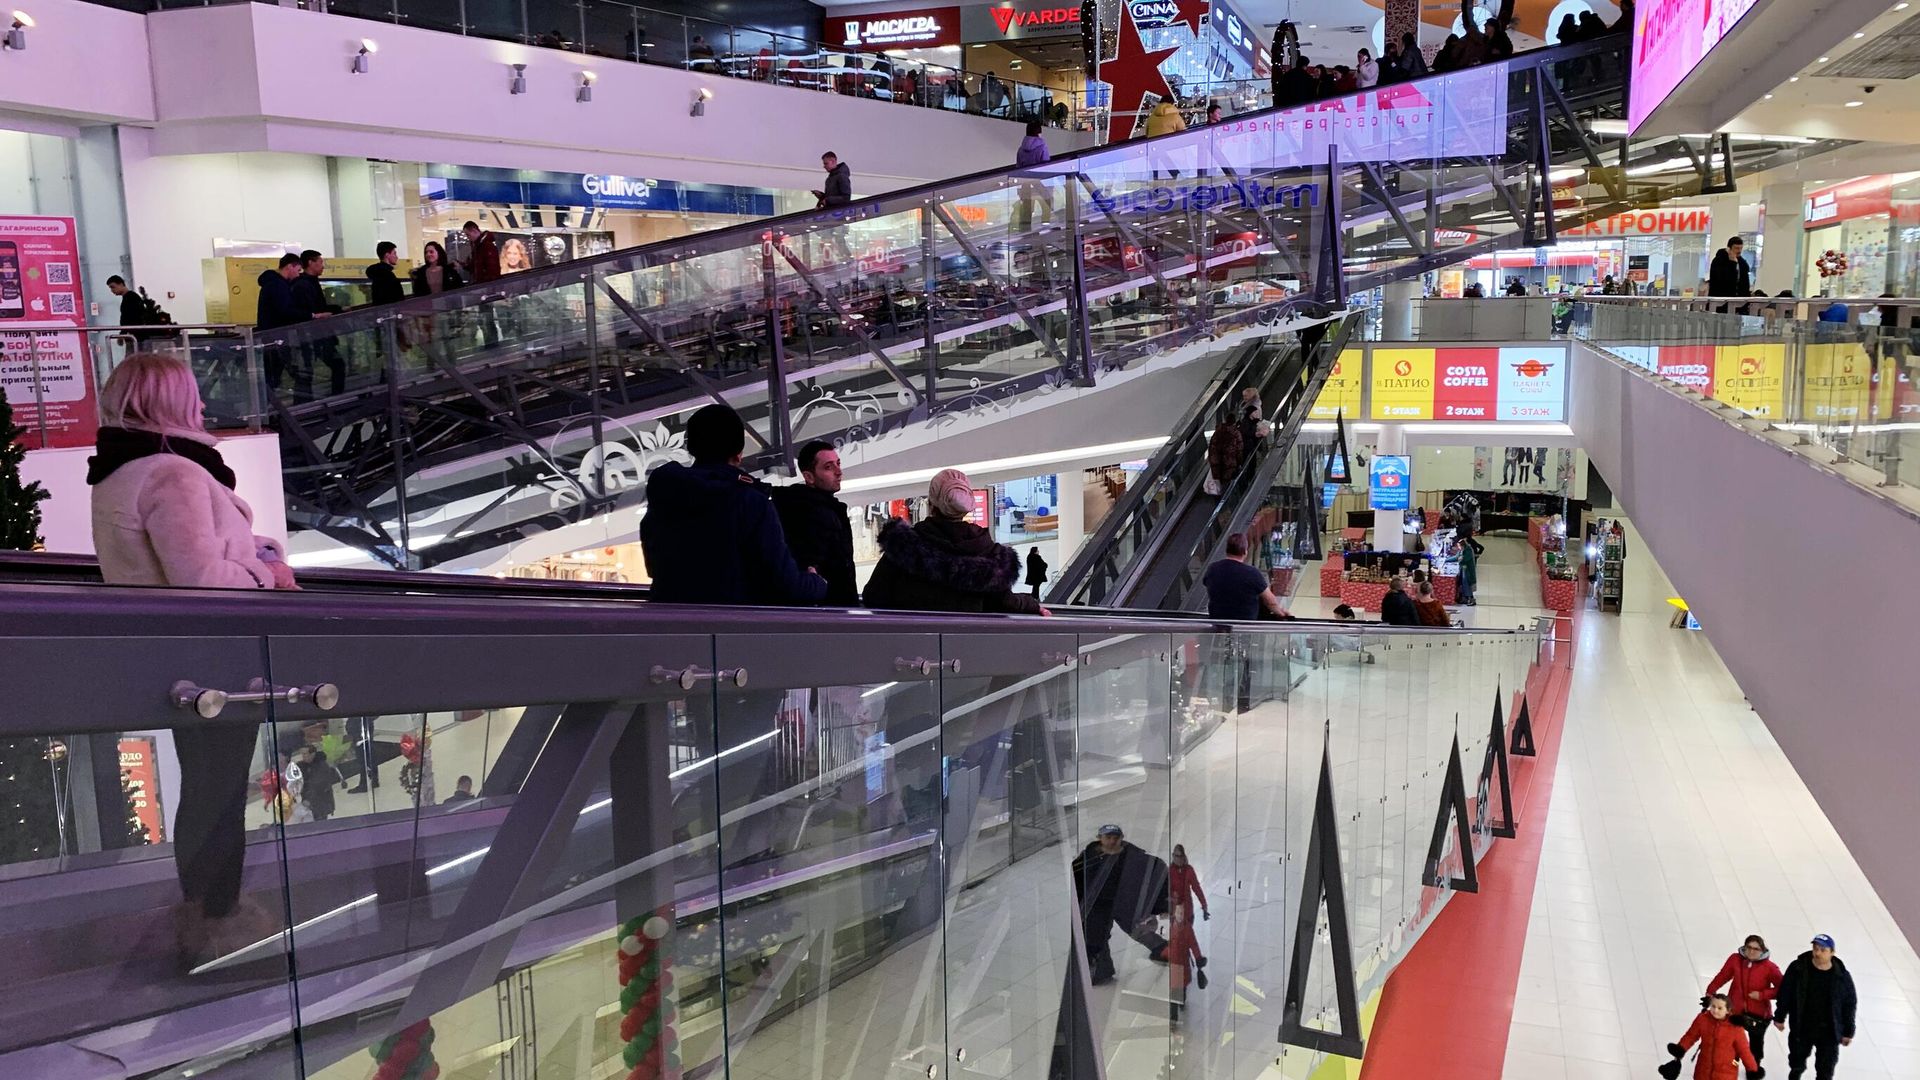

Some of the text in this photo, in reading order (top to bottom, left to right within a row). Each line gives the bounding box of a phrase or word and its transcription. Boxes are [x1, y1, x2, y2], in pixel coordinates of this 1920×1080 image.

[862, 16, 941, 37] МОСИГРА
[582, 173, 650, 197] Gulliver
[5, 330, 58, 338] Полуите
[14, 352, 74, 362] ПОУПКИ
[1446, 366, 1486, 377] COSTA
[1, 375, 73, 385] прилоением
[1384, 379, 1430, 388] ПАТИО
[1443, 377, 1488, 387] COFFEE
[28, 385, 50, 393] ТЦ
[1384, 406, 1390, 415] 2
[1446, 406, 1485, 415] 2 ЭТАЖ
[1512, 407, 1550, 416] 3 ЭТАЖ
